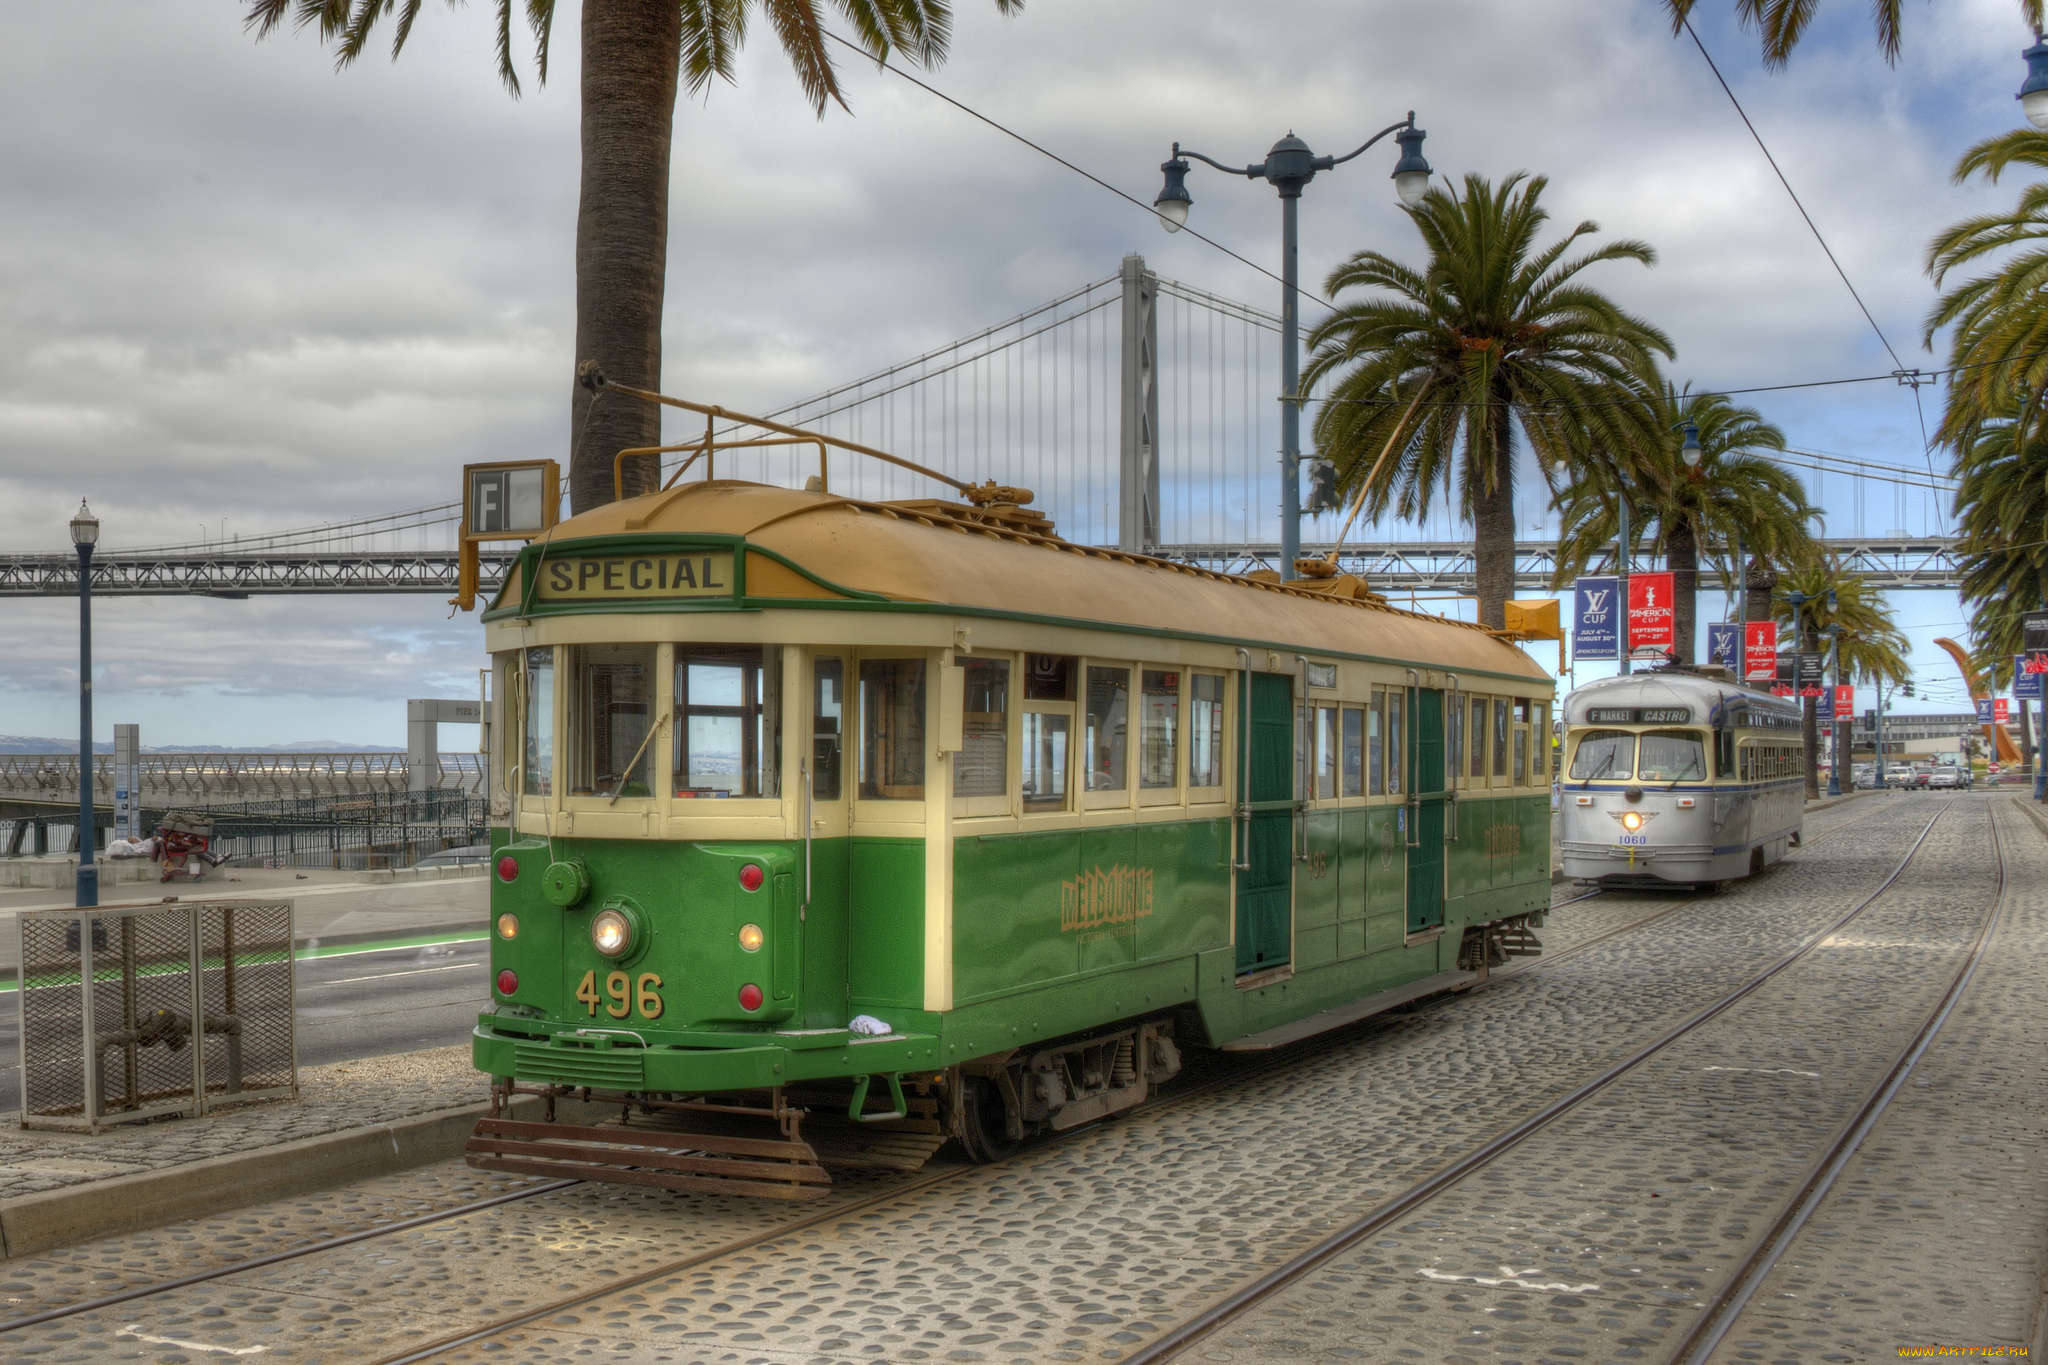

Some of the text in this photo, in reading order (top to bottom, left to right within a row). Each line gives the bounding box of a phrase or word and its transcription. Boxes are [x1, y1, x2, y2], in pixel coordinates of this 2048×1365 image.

[480, 483, 498, 532] F
[550, 557, 724, 592] SPECIAL
[1583, 614, 1606, 624] CUP
[456, 708, 472, 716] PIER
[1592, 710, 1687, 722] F MARKET CASTRO
[1619, 836, 1646, 845] 1060
[1307, 850, 1326, 880] 496
[1061, 862, 1153, 932] MELBOURNE
[576, 969, 665, 1020] 496
